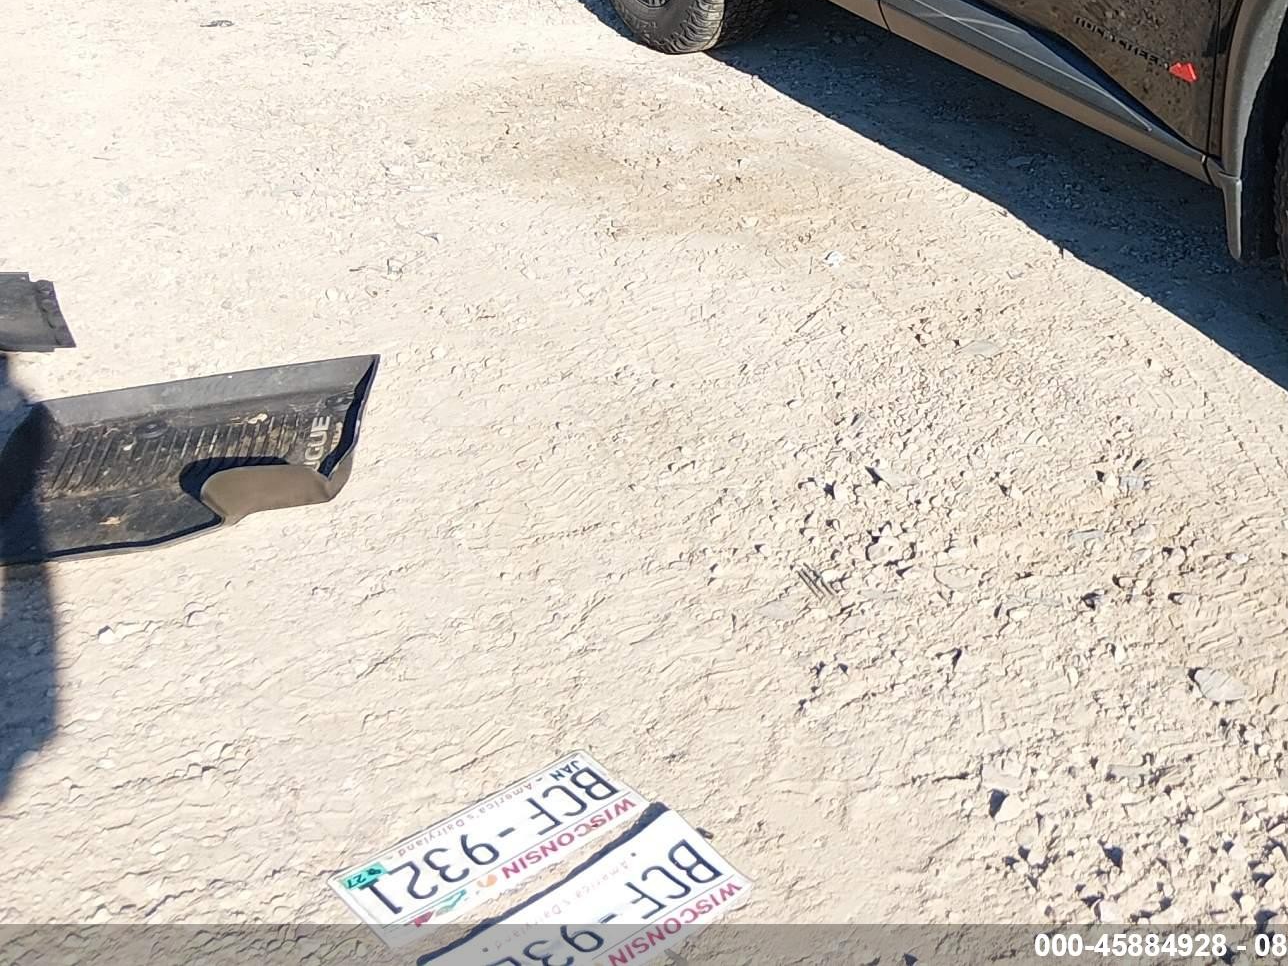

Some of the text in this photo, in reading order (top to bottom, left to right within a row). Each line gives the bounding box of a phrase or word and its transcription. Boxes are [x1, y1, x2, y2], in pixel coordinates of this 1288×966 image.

[550, 760, 579, 781] JAN
[359, 767, 619, 914] BCF-9321
[398, 783, 533, 857] America's Dairyland
[501, 798, 637, 880] WISCONSIN
[608, 882, 742, 966] WISCONSIN
